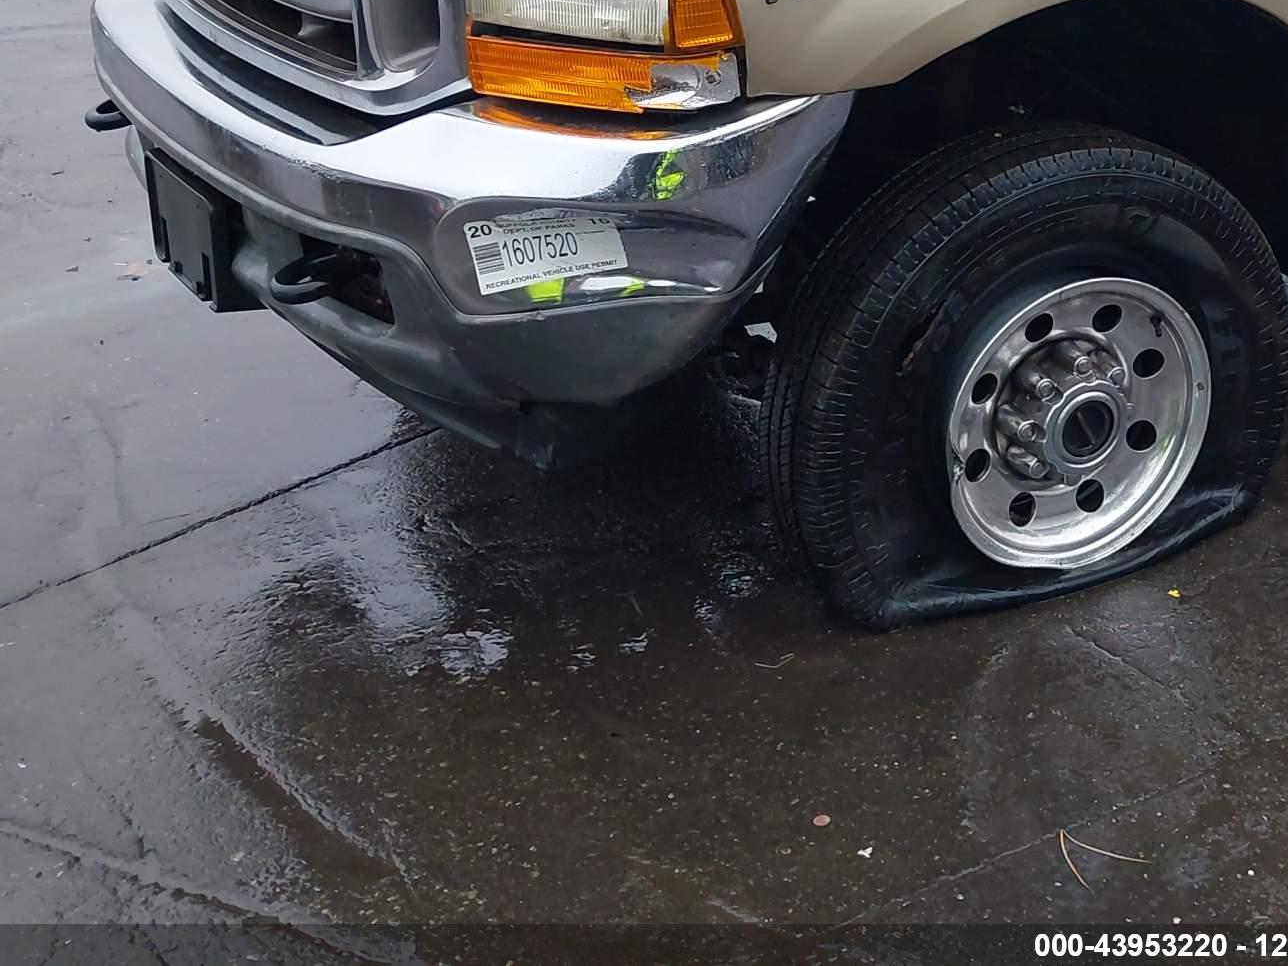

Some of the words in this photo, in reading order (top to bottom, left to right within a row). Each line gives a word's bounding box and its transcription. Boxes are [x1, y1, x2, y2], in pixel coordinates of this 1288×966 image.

[468, 224, 492, 238] 20
[502, 231, 578, 267] 1607520
[485, 273, 541, 290] RECREATIONAL
[543, 265, 574, 277] VEHICLE
[591, 259, 618, 268] PERMIT
